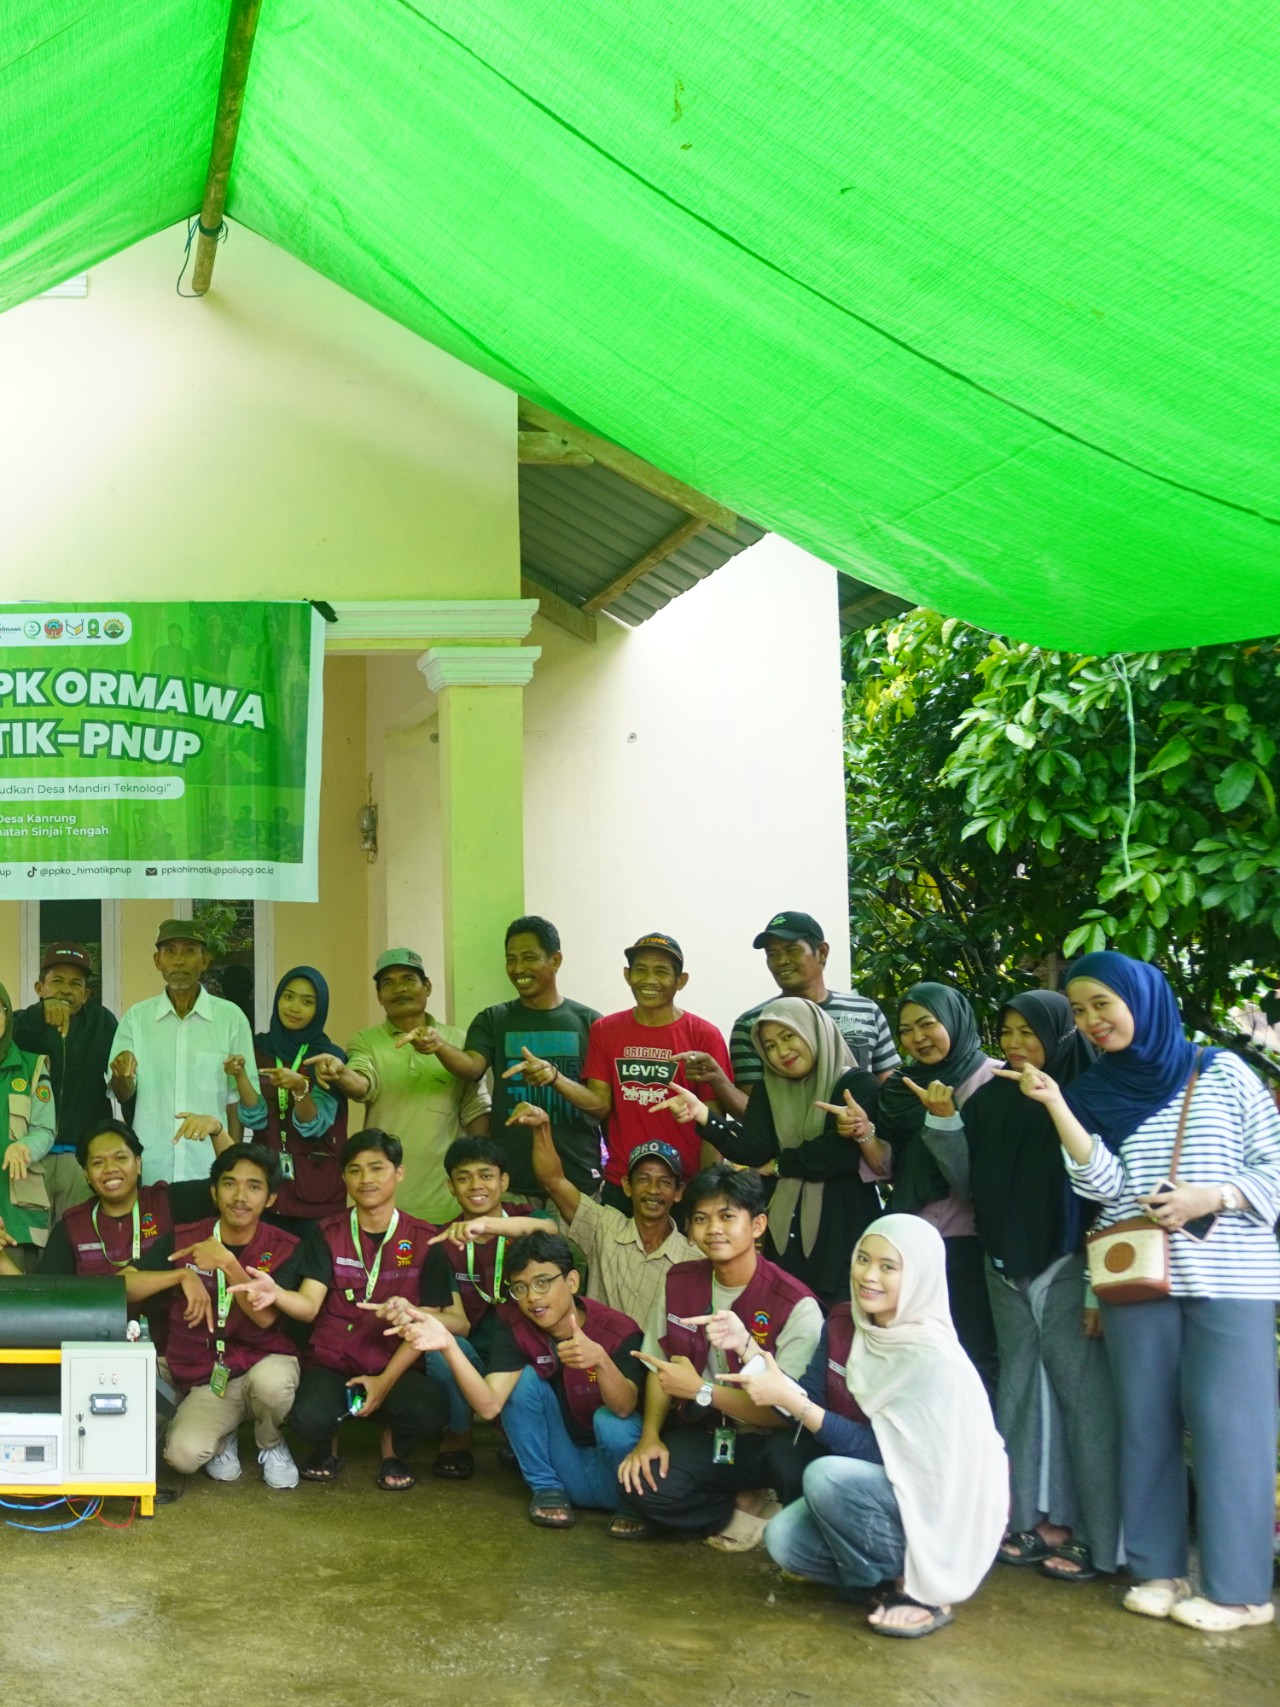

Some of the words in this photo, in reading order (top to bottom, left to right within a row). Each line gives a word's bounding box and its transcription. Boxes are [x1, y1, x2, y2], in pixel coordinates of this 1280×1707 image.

[54, 671, 266, 730] ORMAWA
[37, 784, 65, 794] Desa
[68, 783, 111, 794] Mandiri
[26, 814, 77, 825] Kanrung
[31, 826, 63, 838] Sinjai
[65, 825, 110, 837] Tengah
[39, 865, 132, 877] @ppko_himatikpnup
[161, 865, 274, 877] ppkohimatik@poliupg.ac.id
[143, 1230, 158, 1239] JTIK
[397, 1259, 412, 1267] JTIK
